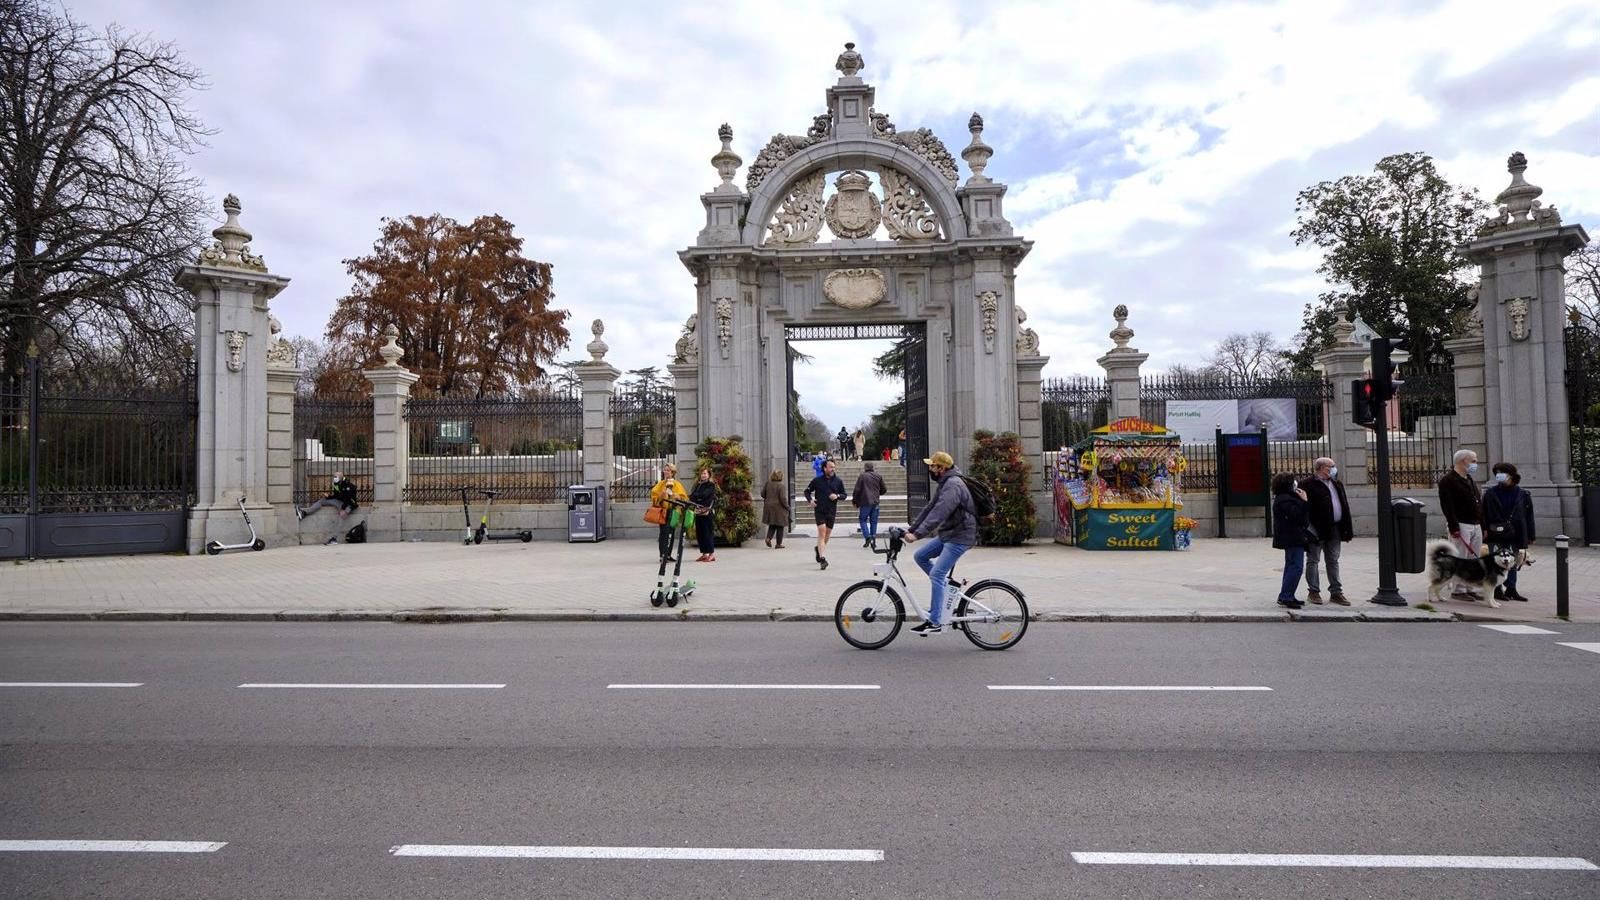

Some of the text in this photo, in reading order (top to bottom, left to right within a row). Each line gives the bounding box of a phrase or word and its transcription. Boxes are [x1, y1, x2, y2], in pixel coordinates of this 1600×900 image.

[1109, 416, 1154, 432] CHUCHES
[1107, 512, 1157, 524] Sweet
[1125, 525, 1139, 535] &
[1106, 536, 1160, 548] Salted
